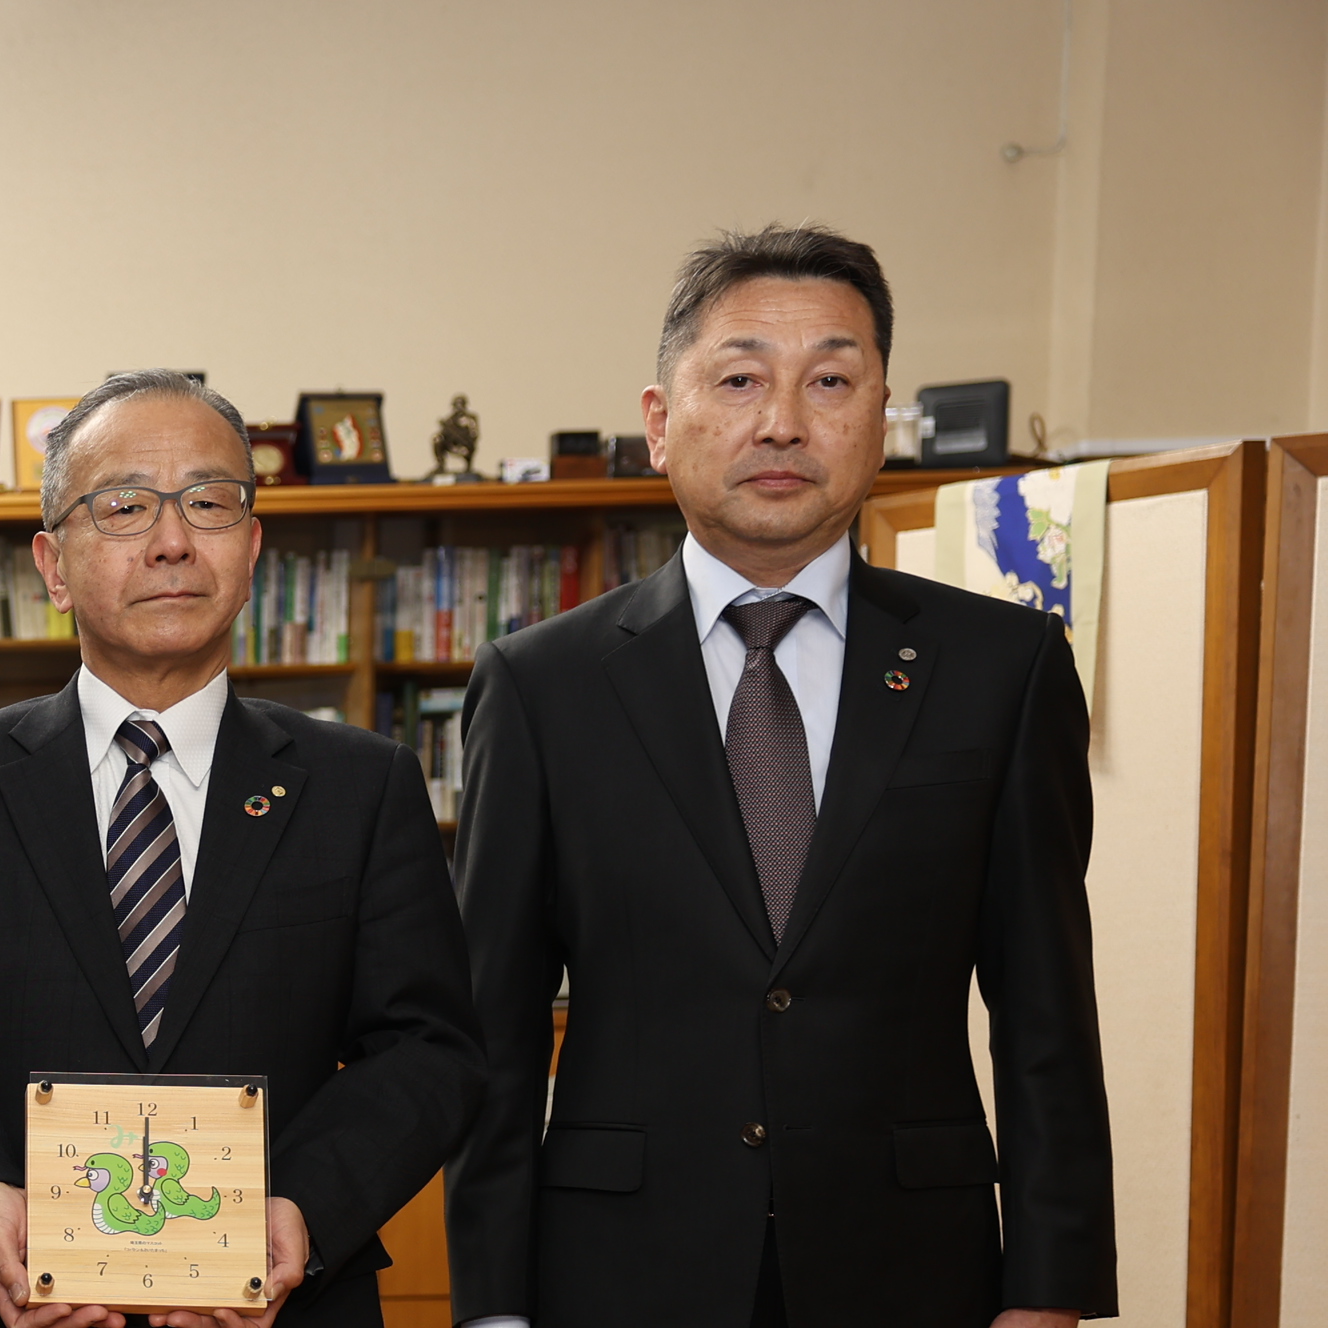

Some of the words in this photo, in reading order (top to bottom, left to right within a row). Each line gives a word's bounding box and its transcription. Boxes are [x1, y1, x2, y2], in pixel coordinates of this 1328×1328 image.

[136, 1102, 158, 1117] 12
[93, 1111, 111, 1125] 11
[190, 1116, 199, 1131] 1
[57, 1143, 76, 1158] 10
[221, 1147, 232, 1161] 2
[50, 1185, 62, 1200] 9
[232, 1189, 243, 1204] 3
[64, 1228, 75, 1242] 8
[217, 1233, 229, 1248] 4
[97, 1262, 108, 1277] 7
[190, 1264, 200, 1279] 5
[143, 1274, 154, 1288] 6
